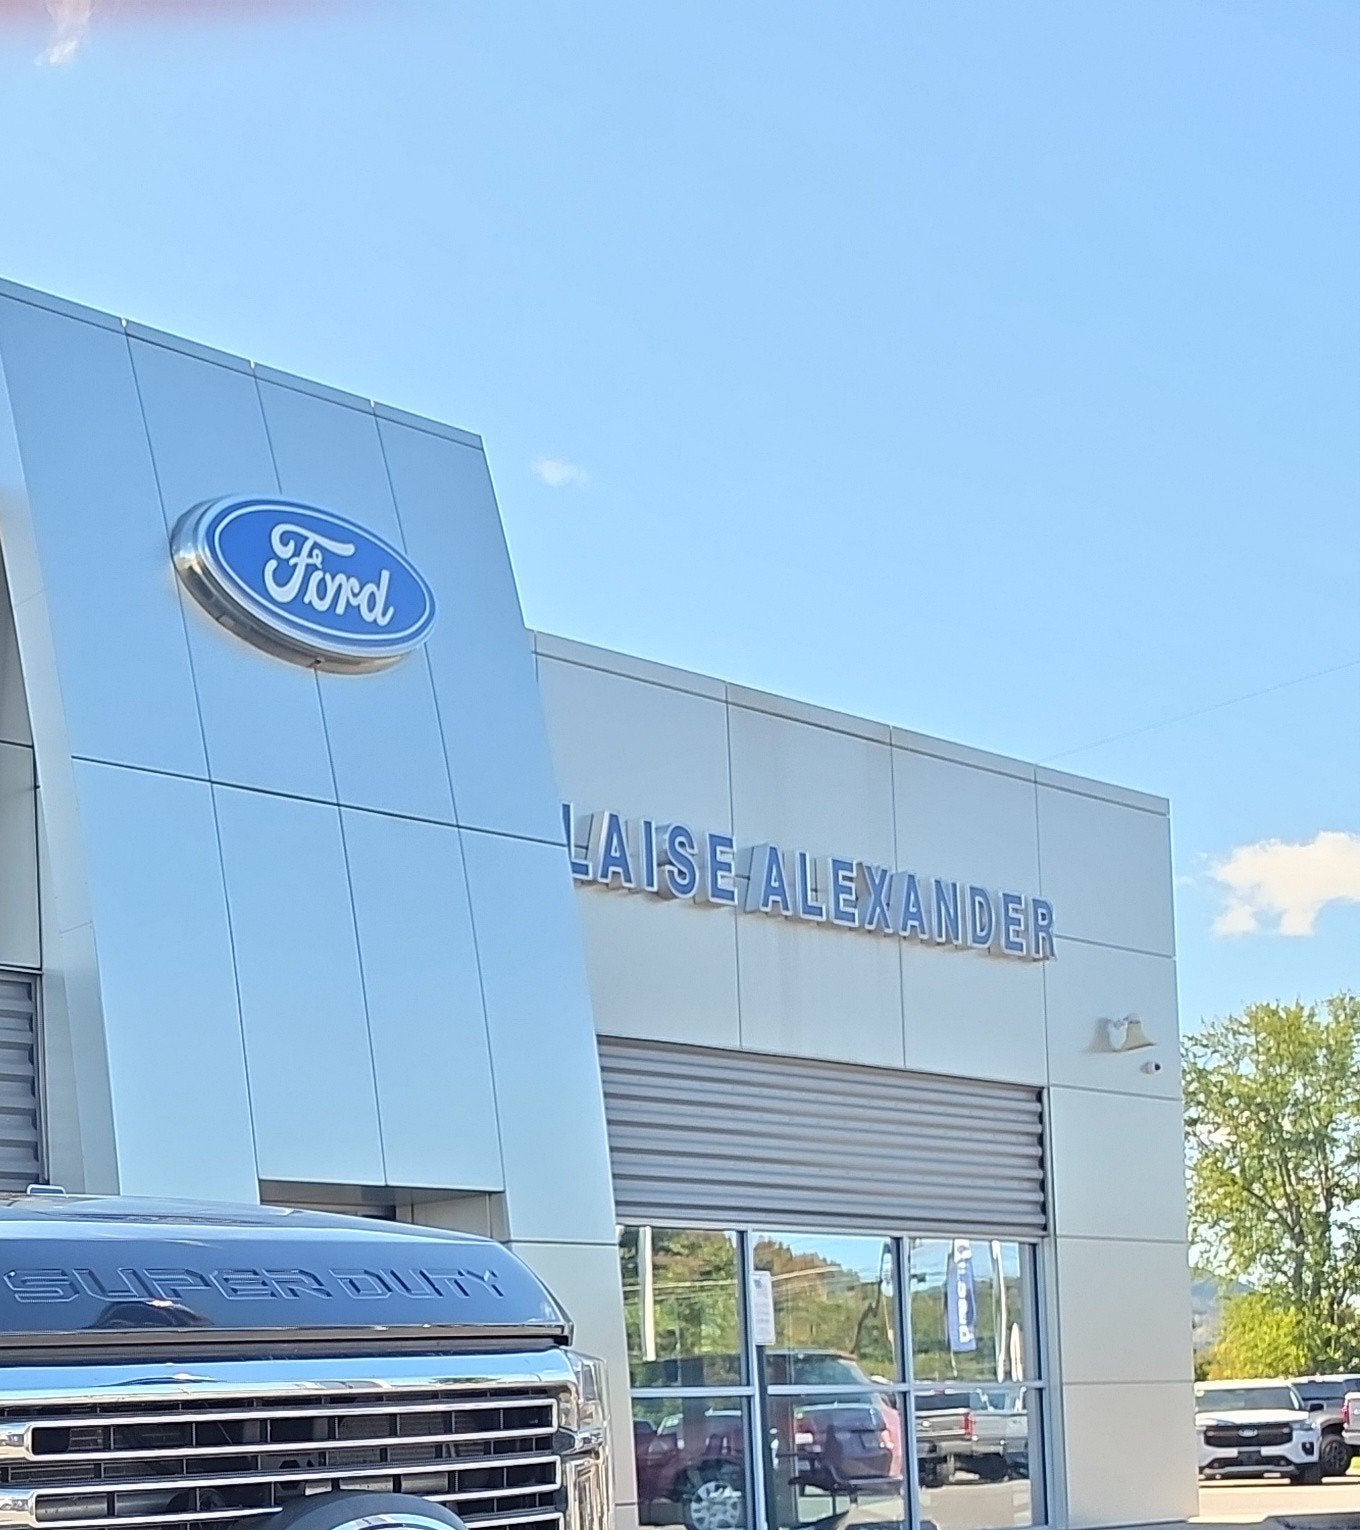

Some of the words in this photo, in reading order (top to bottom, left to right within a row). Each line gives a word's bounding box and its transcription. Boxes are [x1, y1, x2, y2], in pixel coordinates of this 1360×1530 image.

[263, 522, 394, 627] Ford
[561, 802, 738, 906] LAISE
[754, 844, 1058, 961] ALEXANDER
[3, 1266, 327, 1303] SUPER
[328, 1266, 506, 1301] DUTY
